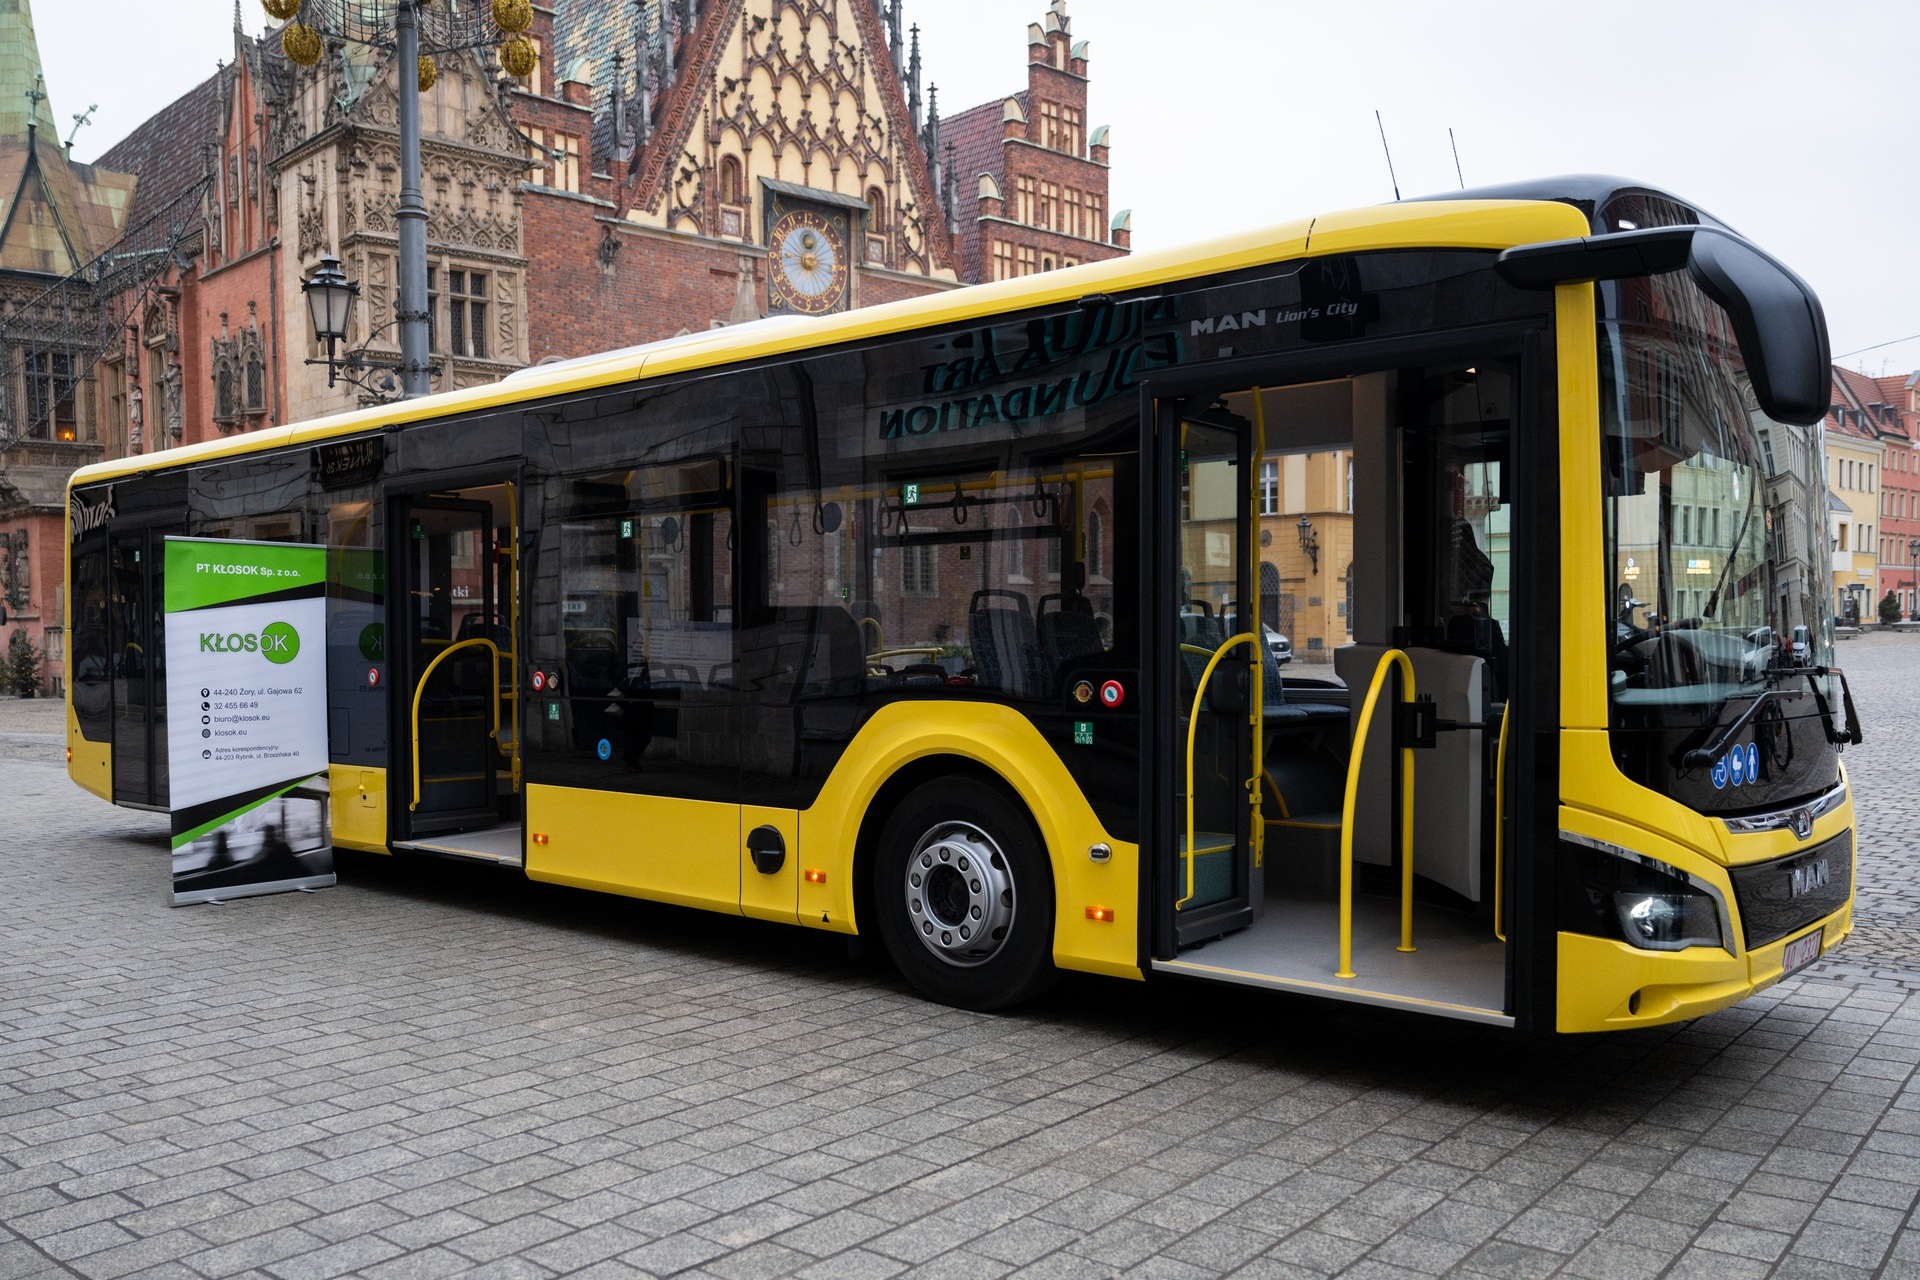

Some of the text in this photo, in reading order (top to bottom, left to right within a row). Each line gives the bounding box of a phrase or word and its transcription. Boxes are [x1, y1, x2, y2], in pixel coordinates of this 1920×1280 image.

[1191, 302, 1358, 336] MAN Lion's City
[196, 563, 210, 573] PT
[213, 564, 258, 575] KŁOSOK
[260, 567, 275, 578] Sp.
[453, 586, 469, 597] tki
[200, 633, 289, 652] KŁOSOK
[239, 688, 256, 697] Żory,
[267, 687, 292, 696] Gajowa
[214, 714, 271, 724] biuro@klosok.eu
[214, 729, 247, 737] klosok.eu
[1789, 860, 1830, 898] MAN
